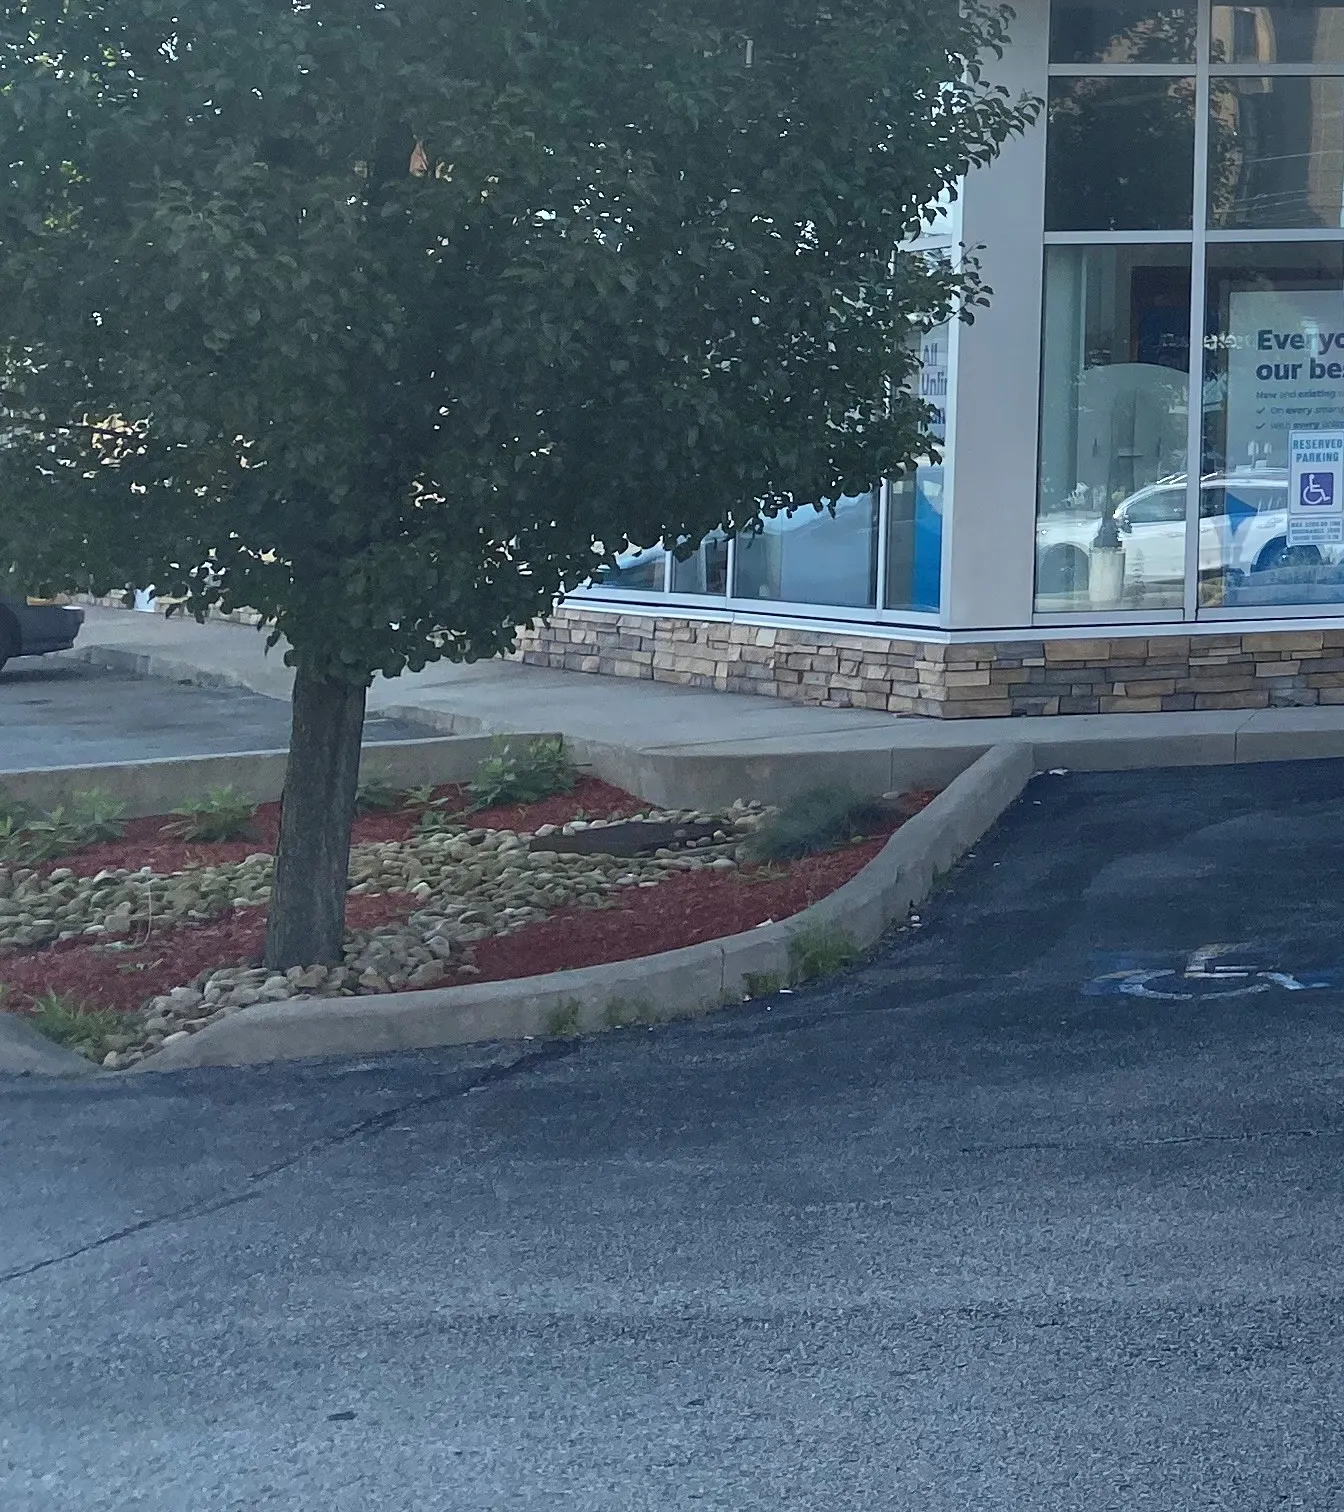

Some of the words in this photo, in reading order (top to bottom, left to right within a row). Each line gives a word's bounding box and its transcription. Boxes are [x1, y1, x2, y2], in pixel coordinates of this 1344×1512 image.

[1256, 361, 1302, 380] our
[1292, 439, 1343, 450] RESERVED
[1296, 452, 1339, 463] PARKING
